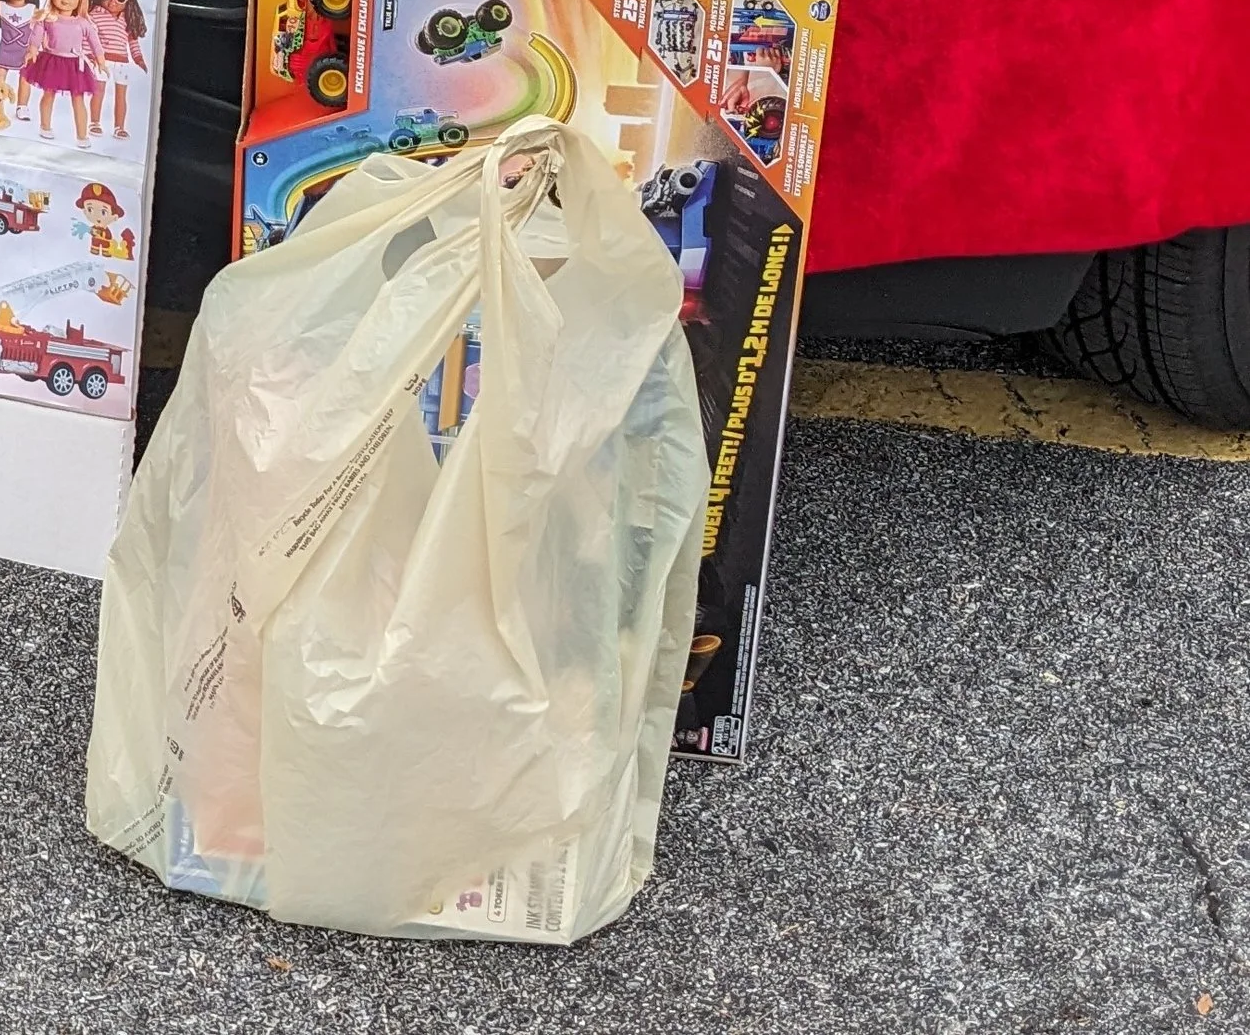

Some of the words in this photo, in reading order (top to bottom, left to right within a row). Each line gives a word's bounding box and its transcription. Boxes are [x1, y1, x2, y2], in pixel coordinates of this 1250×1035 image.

[354, 38, 365, 93] EXCLUSIVE
[704, 64, 712, 84] PEUT
[806, 48, 818, 93] ASCENSEUR
[710, 64, 720, 104] CONTENIR
[794, 71, 803, 108] WORKING
[783, 163, 792, 192] LIGHTS
[753, 294, 776, 317] DE
[750, 319, 769, 334] M
[727, 382, 753, 429] PLUS
[358, 453, 370, 468] AND
[714, 437, 740, 484] FEET!
[309, 493, 326, 508] Today
[703, 506, 724, 549] OVER
[526, 910, 541, 929] INK
